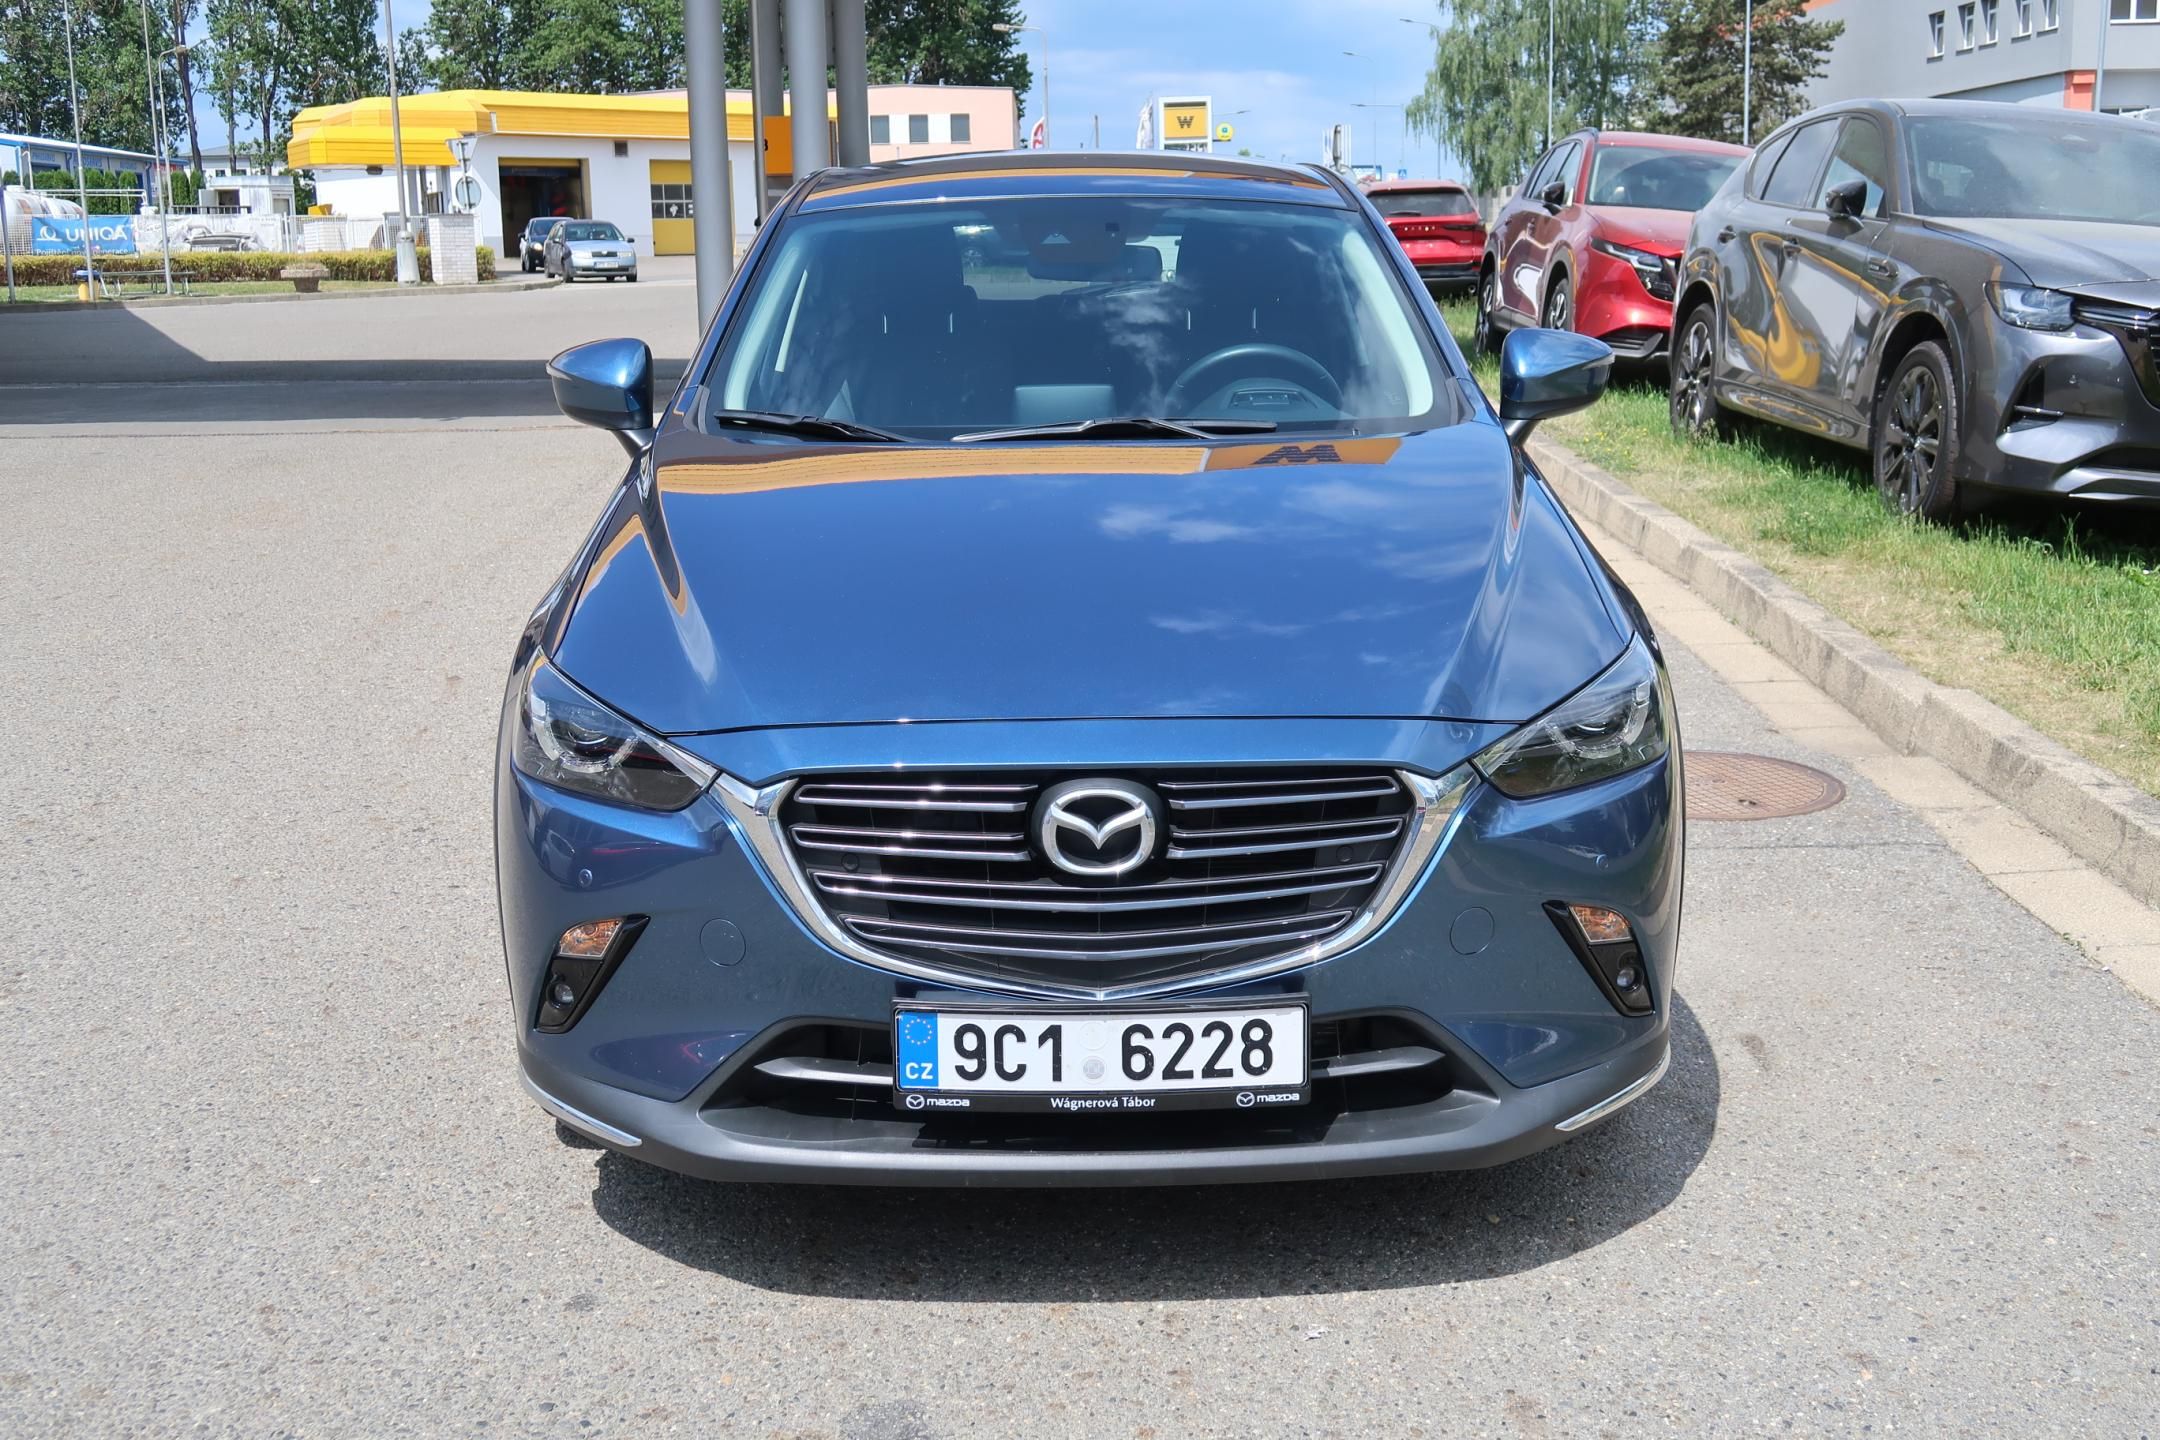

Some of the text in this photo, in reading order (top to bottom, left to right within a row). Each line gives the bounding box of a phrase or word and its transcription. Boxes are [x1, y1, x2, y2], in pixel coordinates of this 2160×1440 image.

[64, 224, 128, 242] UNIQA
[953, 1018, 1274, 1082] 9C1 6228
[905, 1062, 934, 1080] CZ
[1050, 1095, 1156, 1111] Wágnerová Tábor
